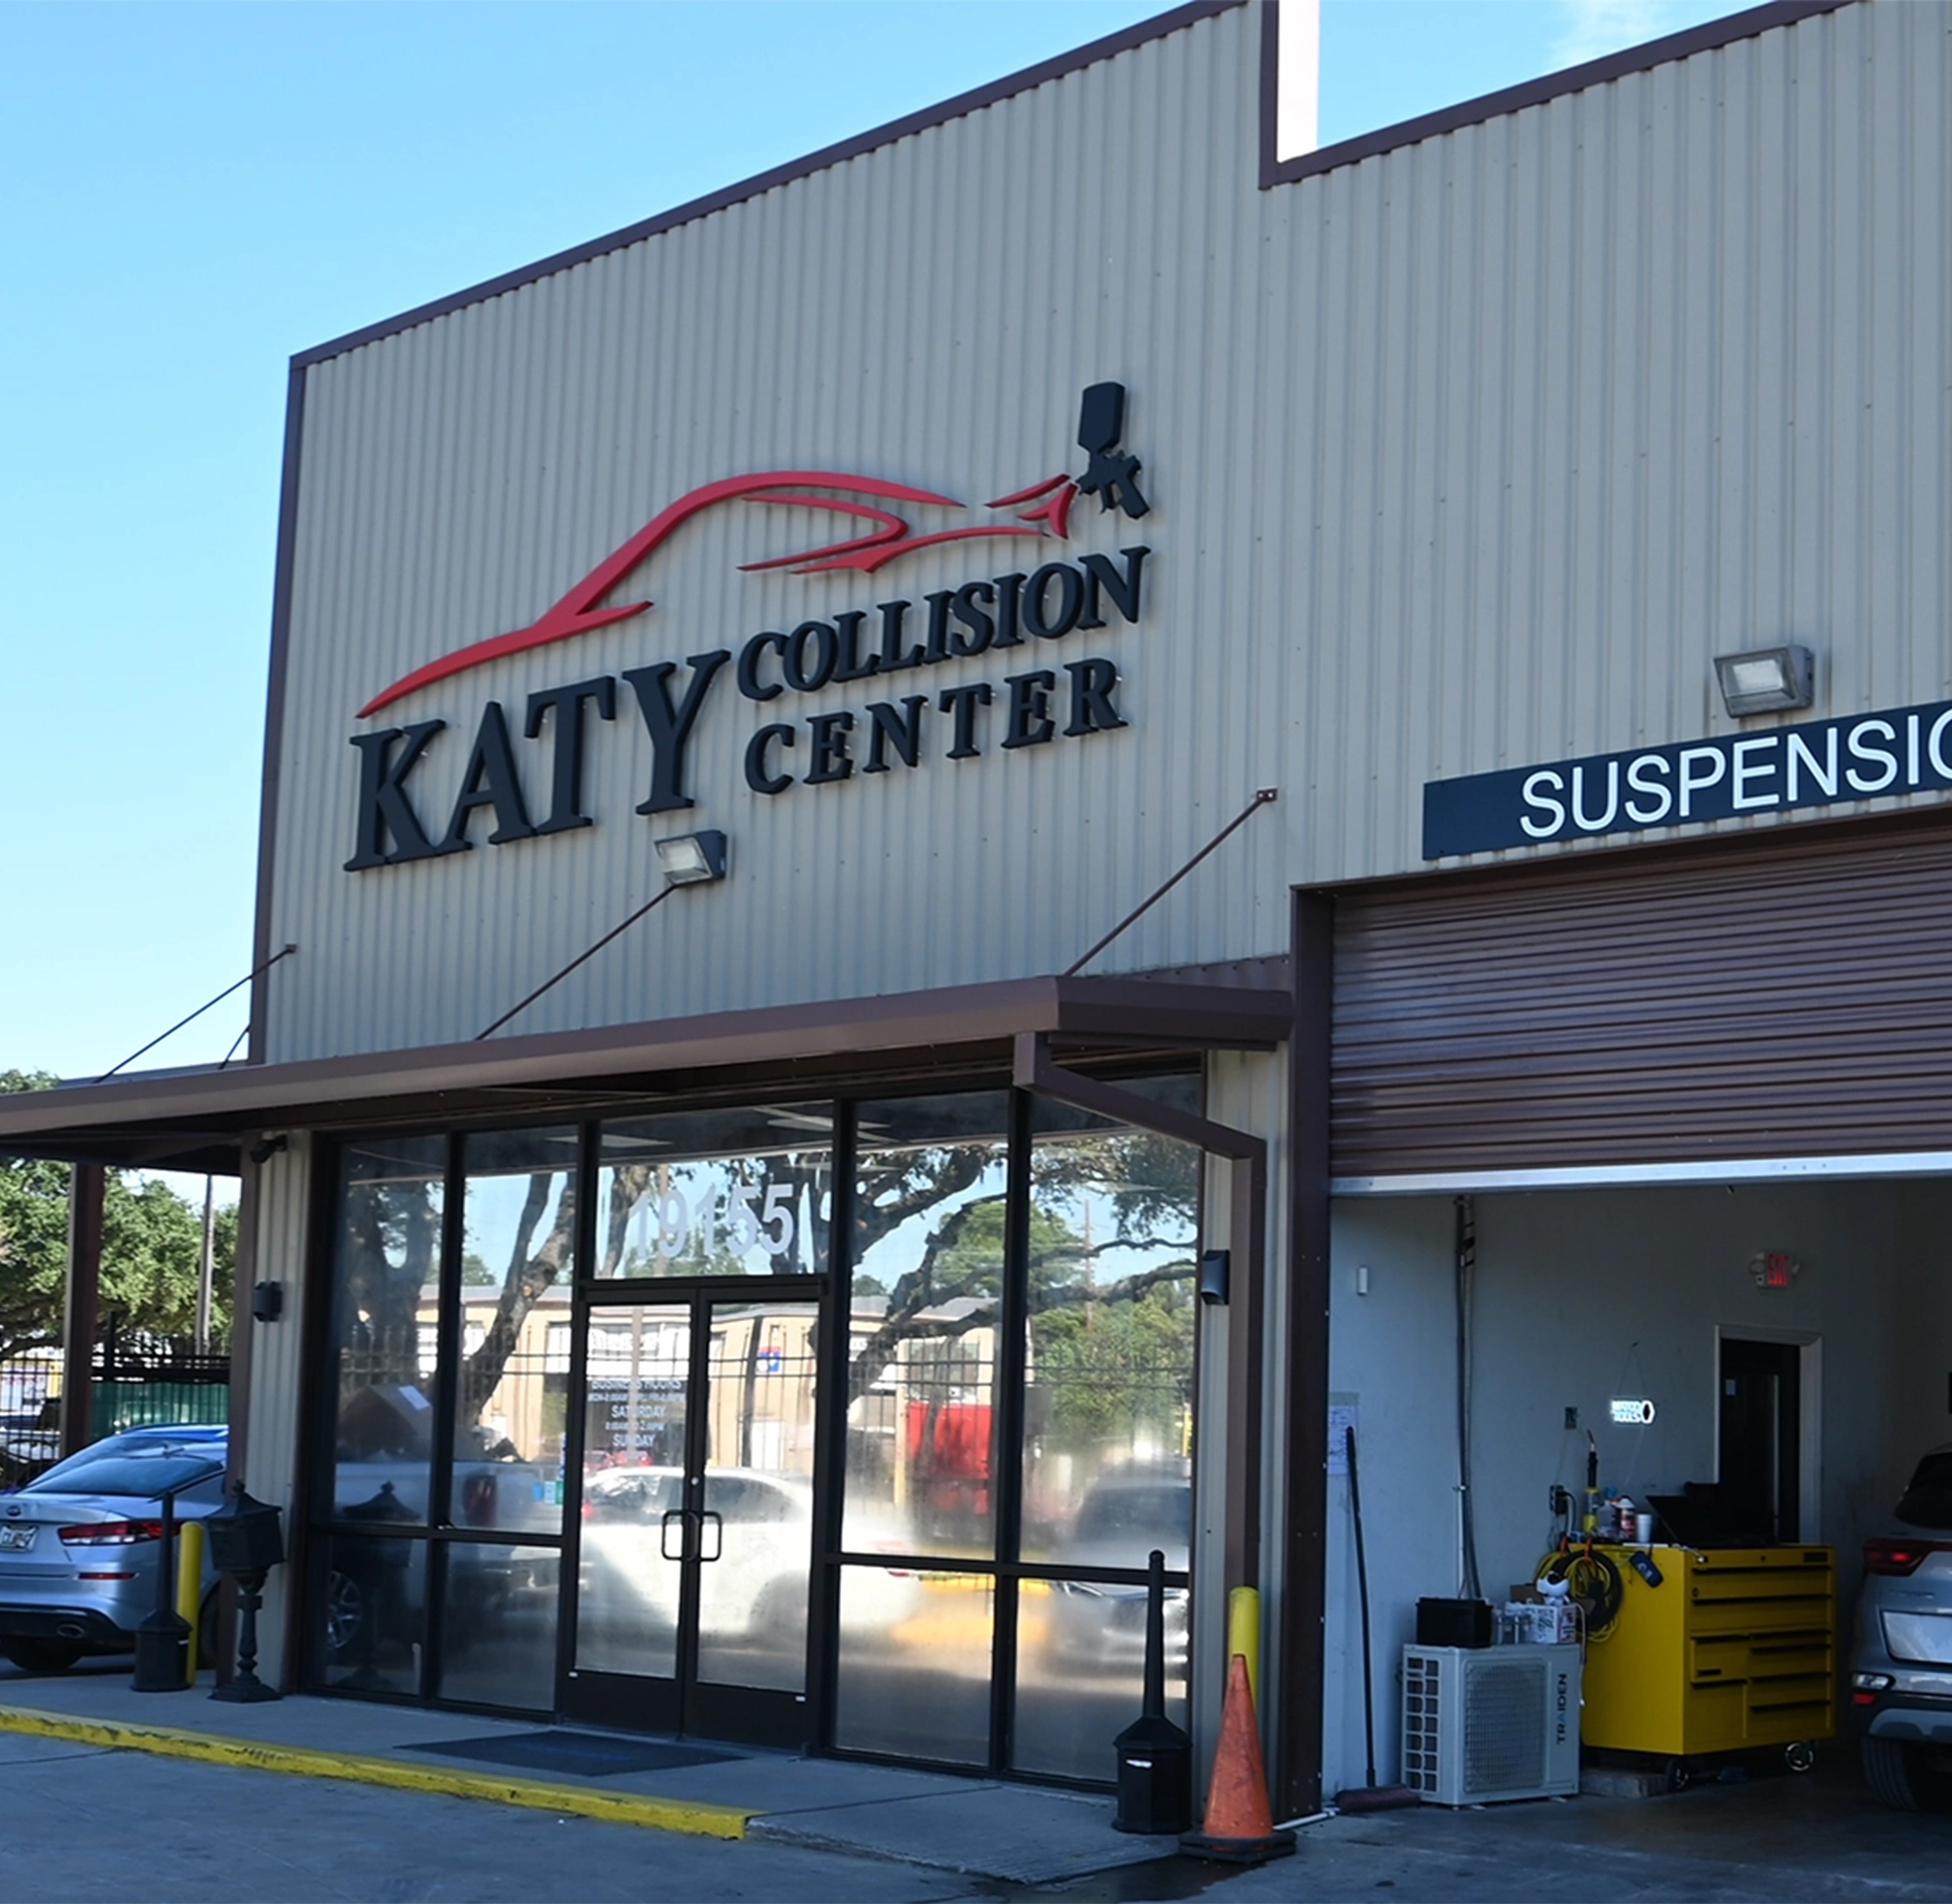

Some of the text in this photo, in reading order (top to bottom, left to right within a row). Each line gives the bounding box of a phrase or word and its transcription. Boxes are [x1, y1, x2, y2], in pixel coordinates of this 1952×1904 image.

[736, 545, 1151, 701] COLLISION
[343, 650, 731, 872] KATY
[744, 657, 1128, 794] CENTER
[629, 1182, 793, 1258] 19155
[612, 1434, 656, 1447] SUNDAY
[1556, 1672, 1567, 1744] TRAIDEN
